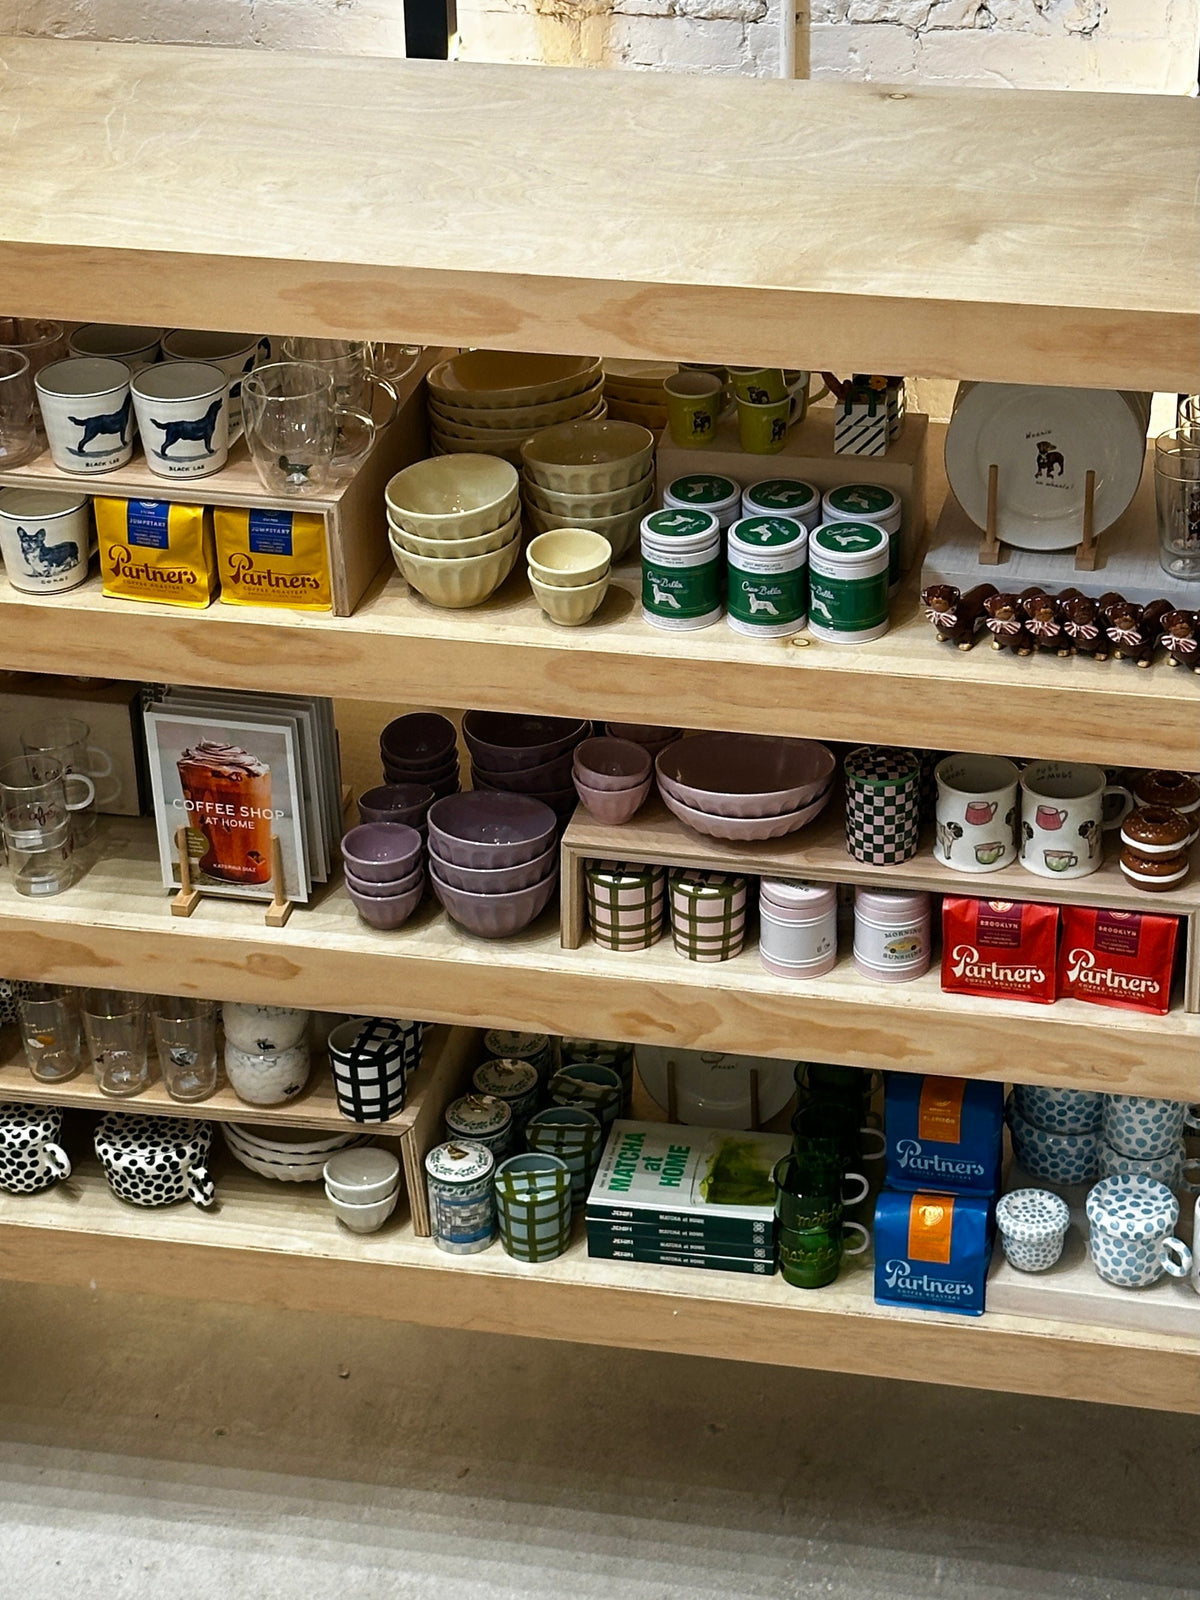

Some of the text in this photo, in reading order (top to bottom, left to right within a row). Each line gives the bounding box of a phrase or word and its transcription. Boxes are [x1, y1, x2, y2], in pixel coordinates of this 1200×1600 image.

[251, 527, 290, 535] JUMPSTART
[108, 544, 197, 585] Partners
[228, 552, 320, 589] Partners
[172, 798, 285, 821] COFFEE SHOP
[205, 816, 256, 830] AT HOME
[979, 920, 1019, 929] BROOKLYN
[1098, 925, 1137, 937] BROOKLYN
[951, 944, 1046, 983] Partners
[1066, 948, 1160, 994] Partners
[965, 977, 992, 985] COFFEE
[994, 981, 1032, 989] ROASTERS
[1078, 983, 1106, 992] COFFEE
[1108, 988, 1145, 999] ROASTERS
[608, 1132, 647, 1192] MATCHA
[642, 1156, 664, 1172] at
[658, 1144, 691, 1187] HOME
[896, 1139, 985, 1175] Partners
[884, 1259, 974, 1295] Partners
